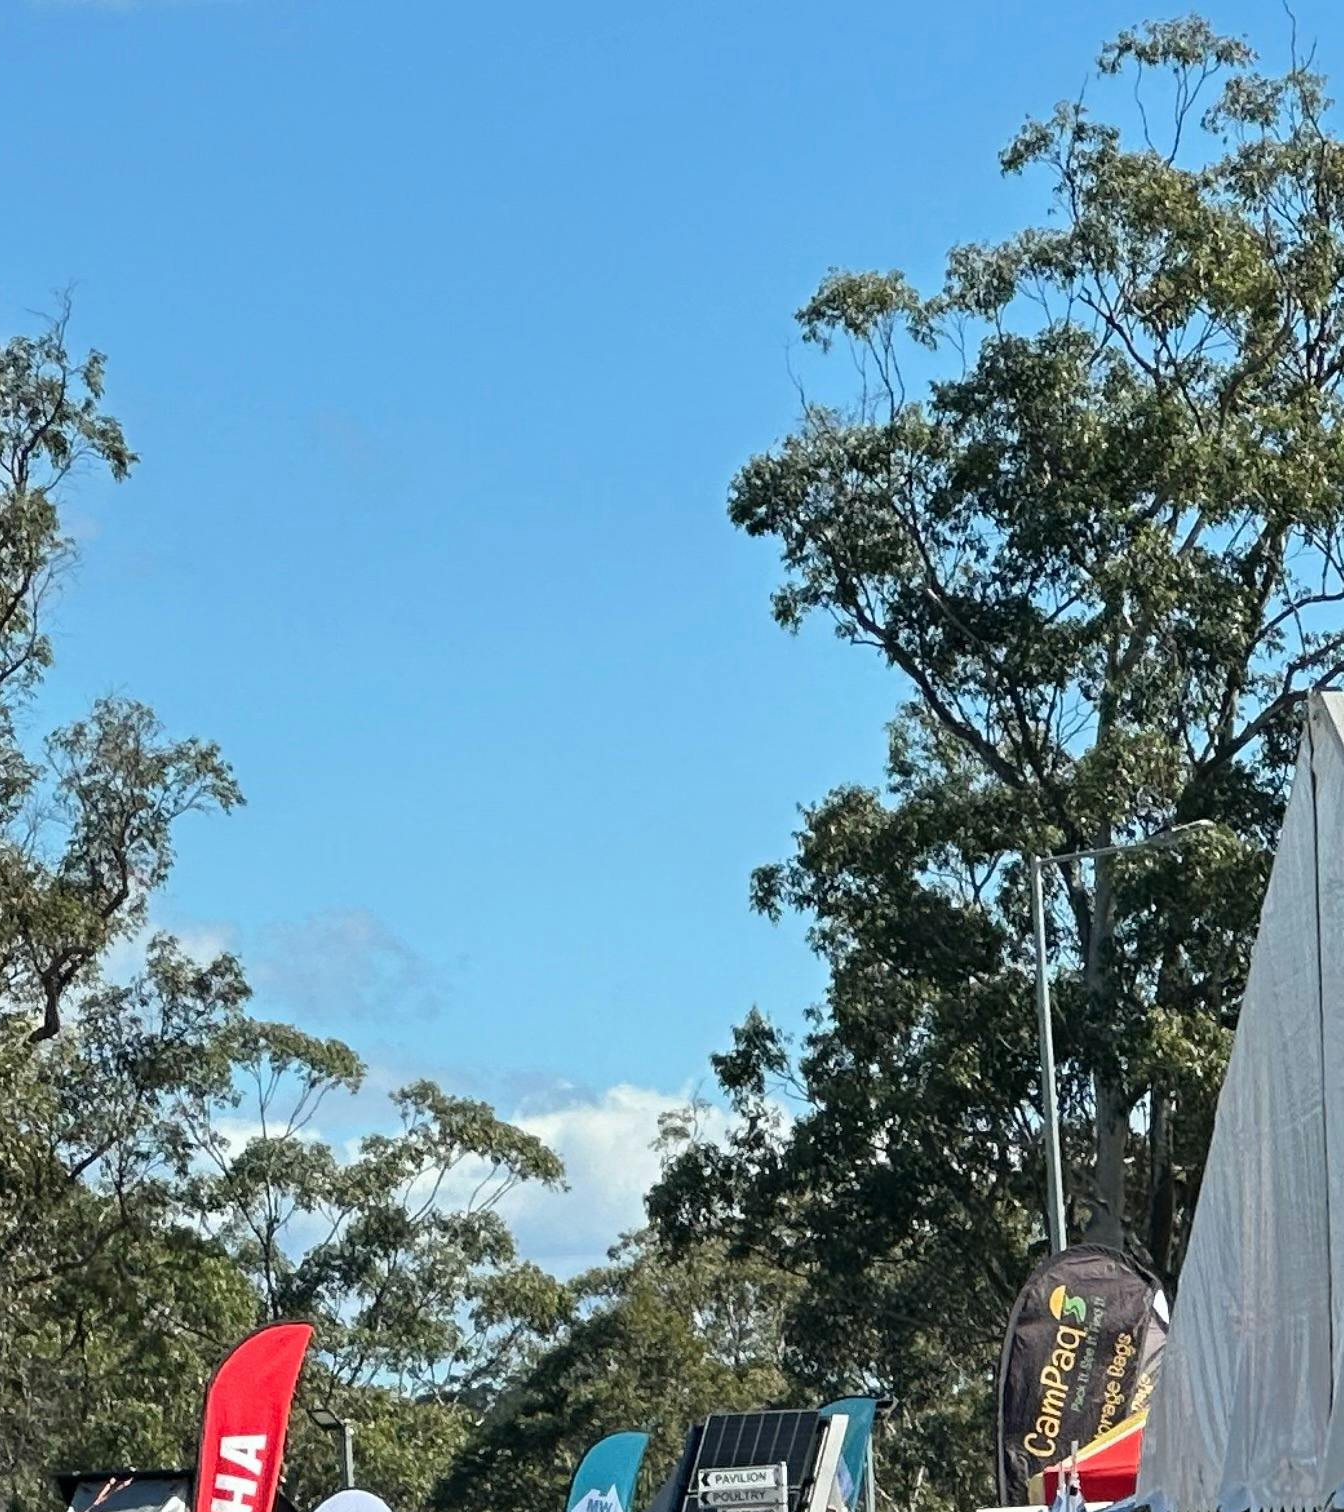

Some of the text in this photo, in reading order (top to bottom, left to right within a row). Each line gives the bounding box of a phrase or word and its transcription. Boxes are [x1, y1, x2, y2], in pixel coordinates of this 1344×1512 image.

[1024, 1325, 1088, 1457] CamPaq
[714, 1472, 767, 1485] PAVILION
[713, 1490, 766, 1502] POULTRY
